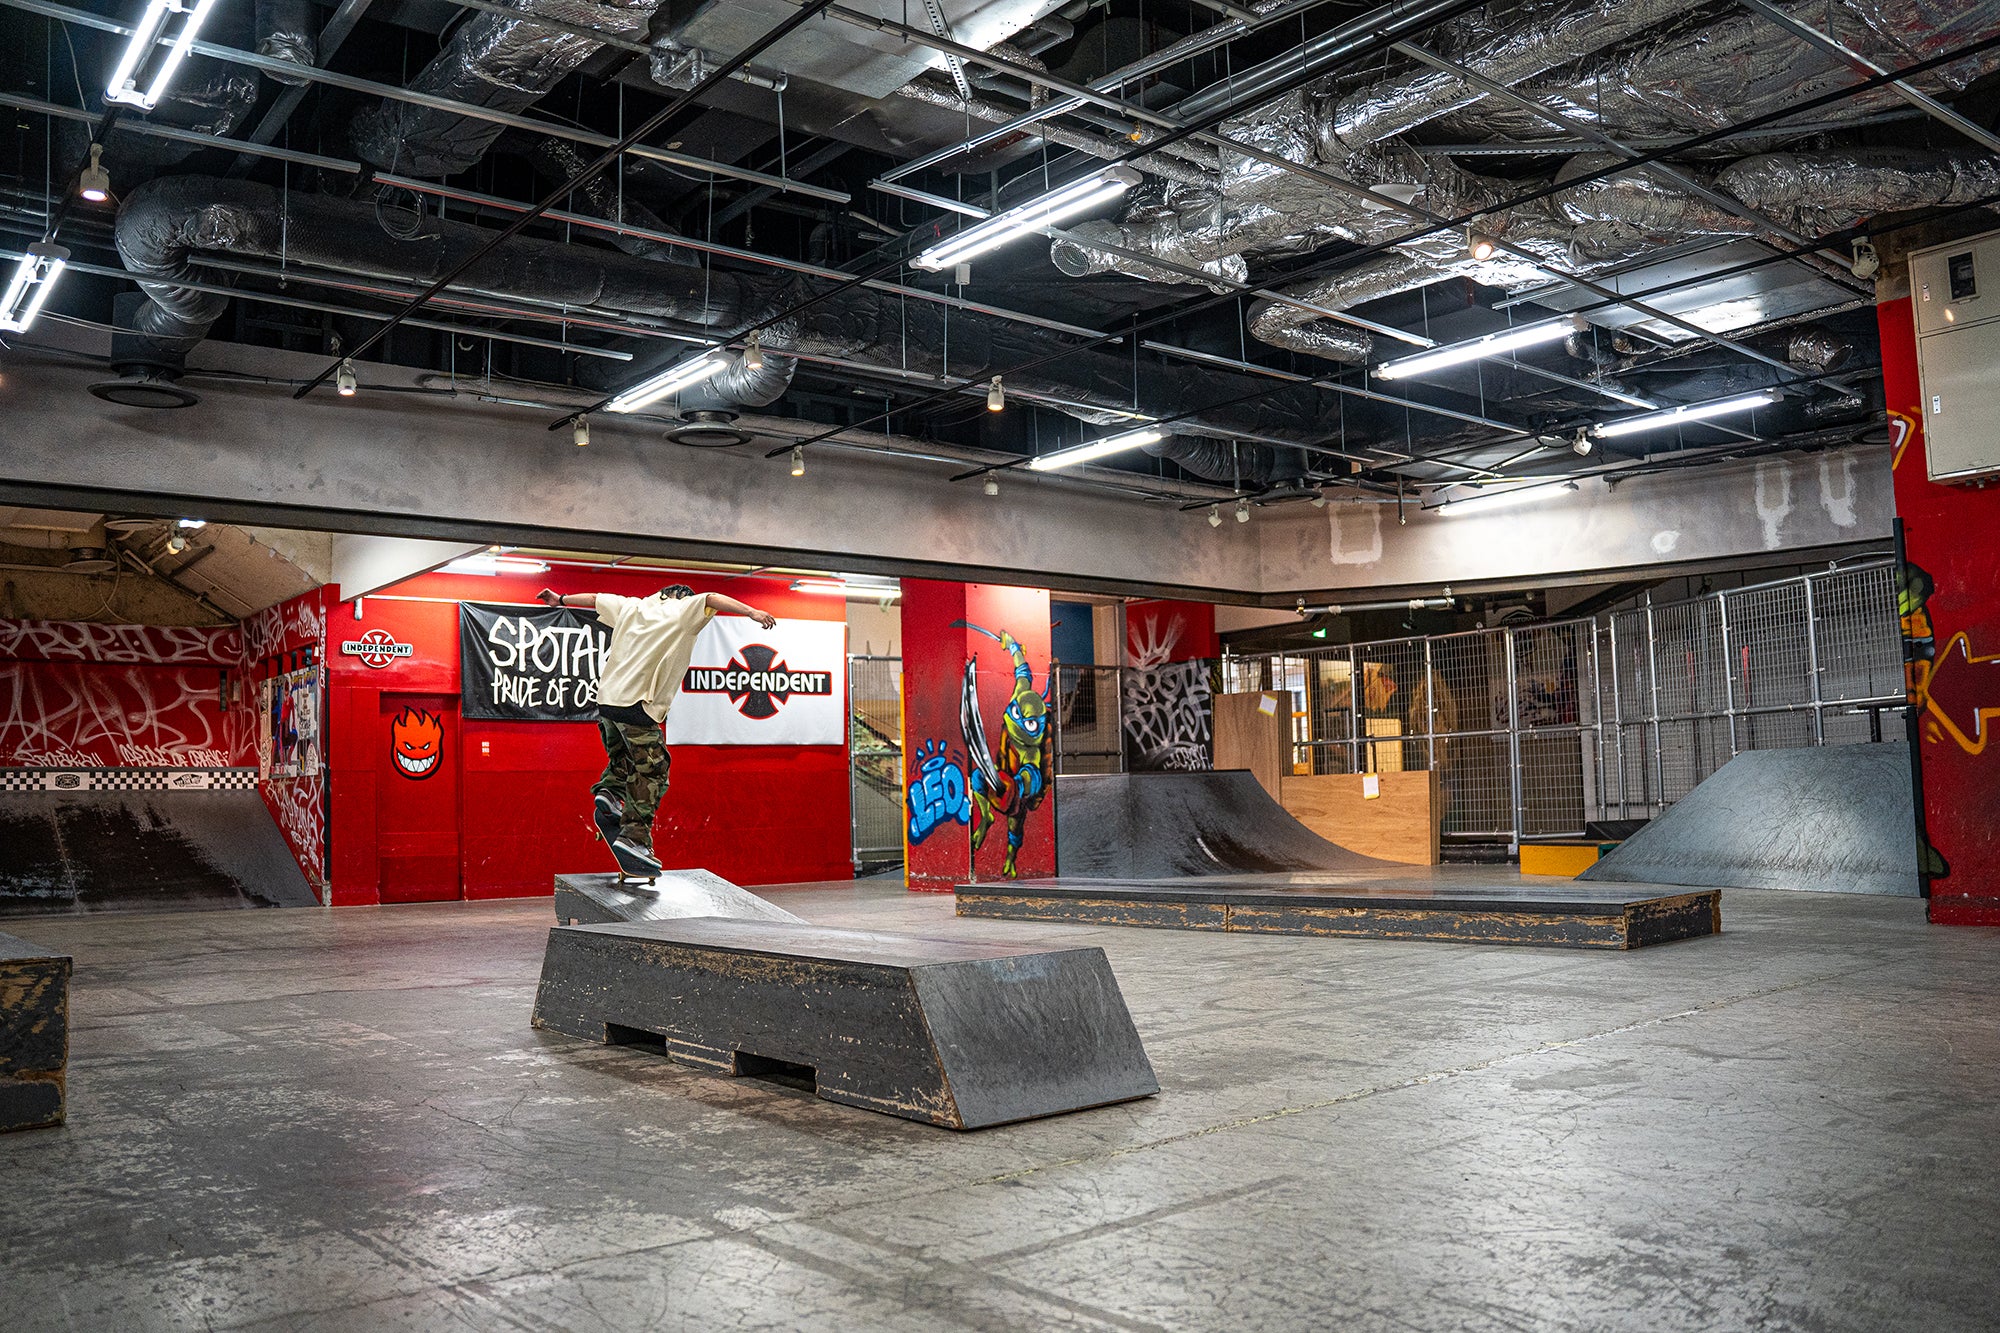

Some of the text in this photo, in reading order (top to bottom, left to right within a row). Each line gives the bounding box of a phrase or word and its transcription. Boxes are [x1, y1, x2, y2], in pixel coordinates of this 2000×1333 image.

[346, 643, 409, 654] INDEPENDENT
[488, 615, 611, 680] SPOTAK
[491, 667, 542, 708] PRIDE
[546, 678, 571, 708] OF
[690, 670, 826, 693] INDEPENDENT
[908, 760, 969, 842] LEO
